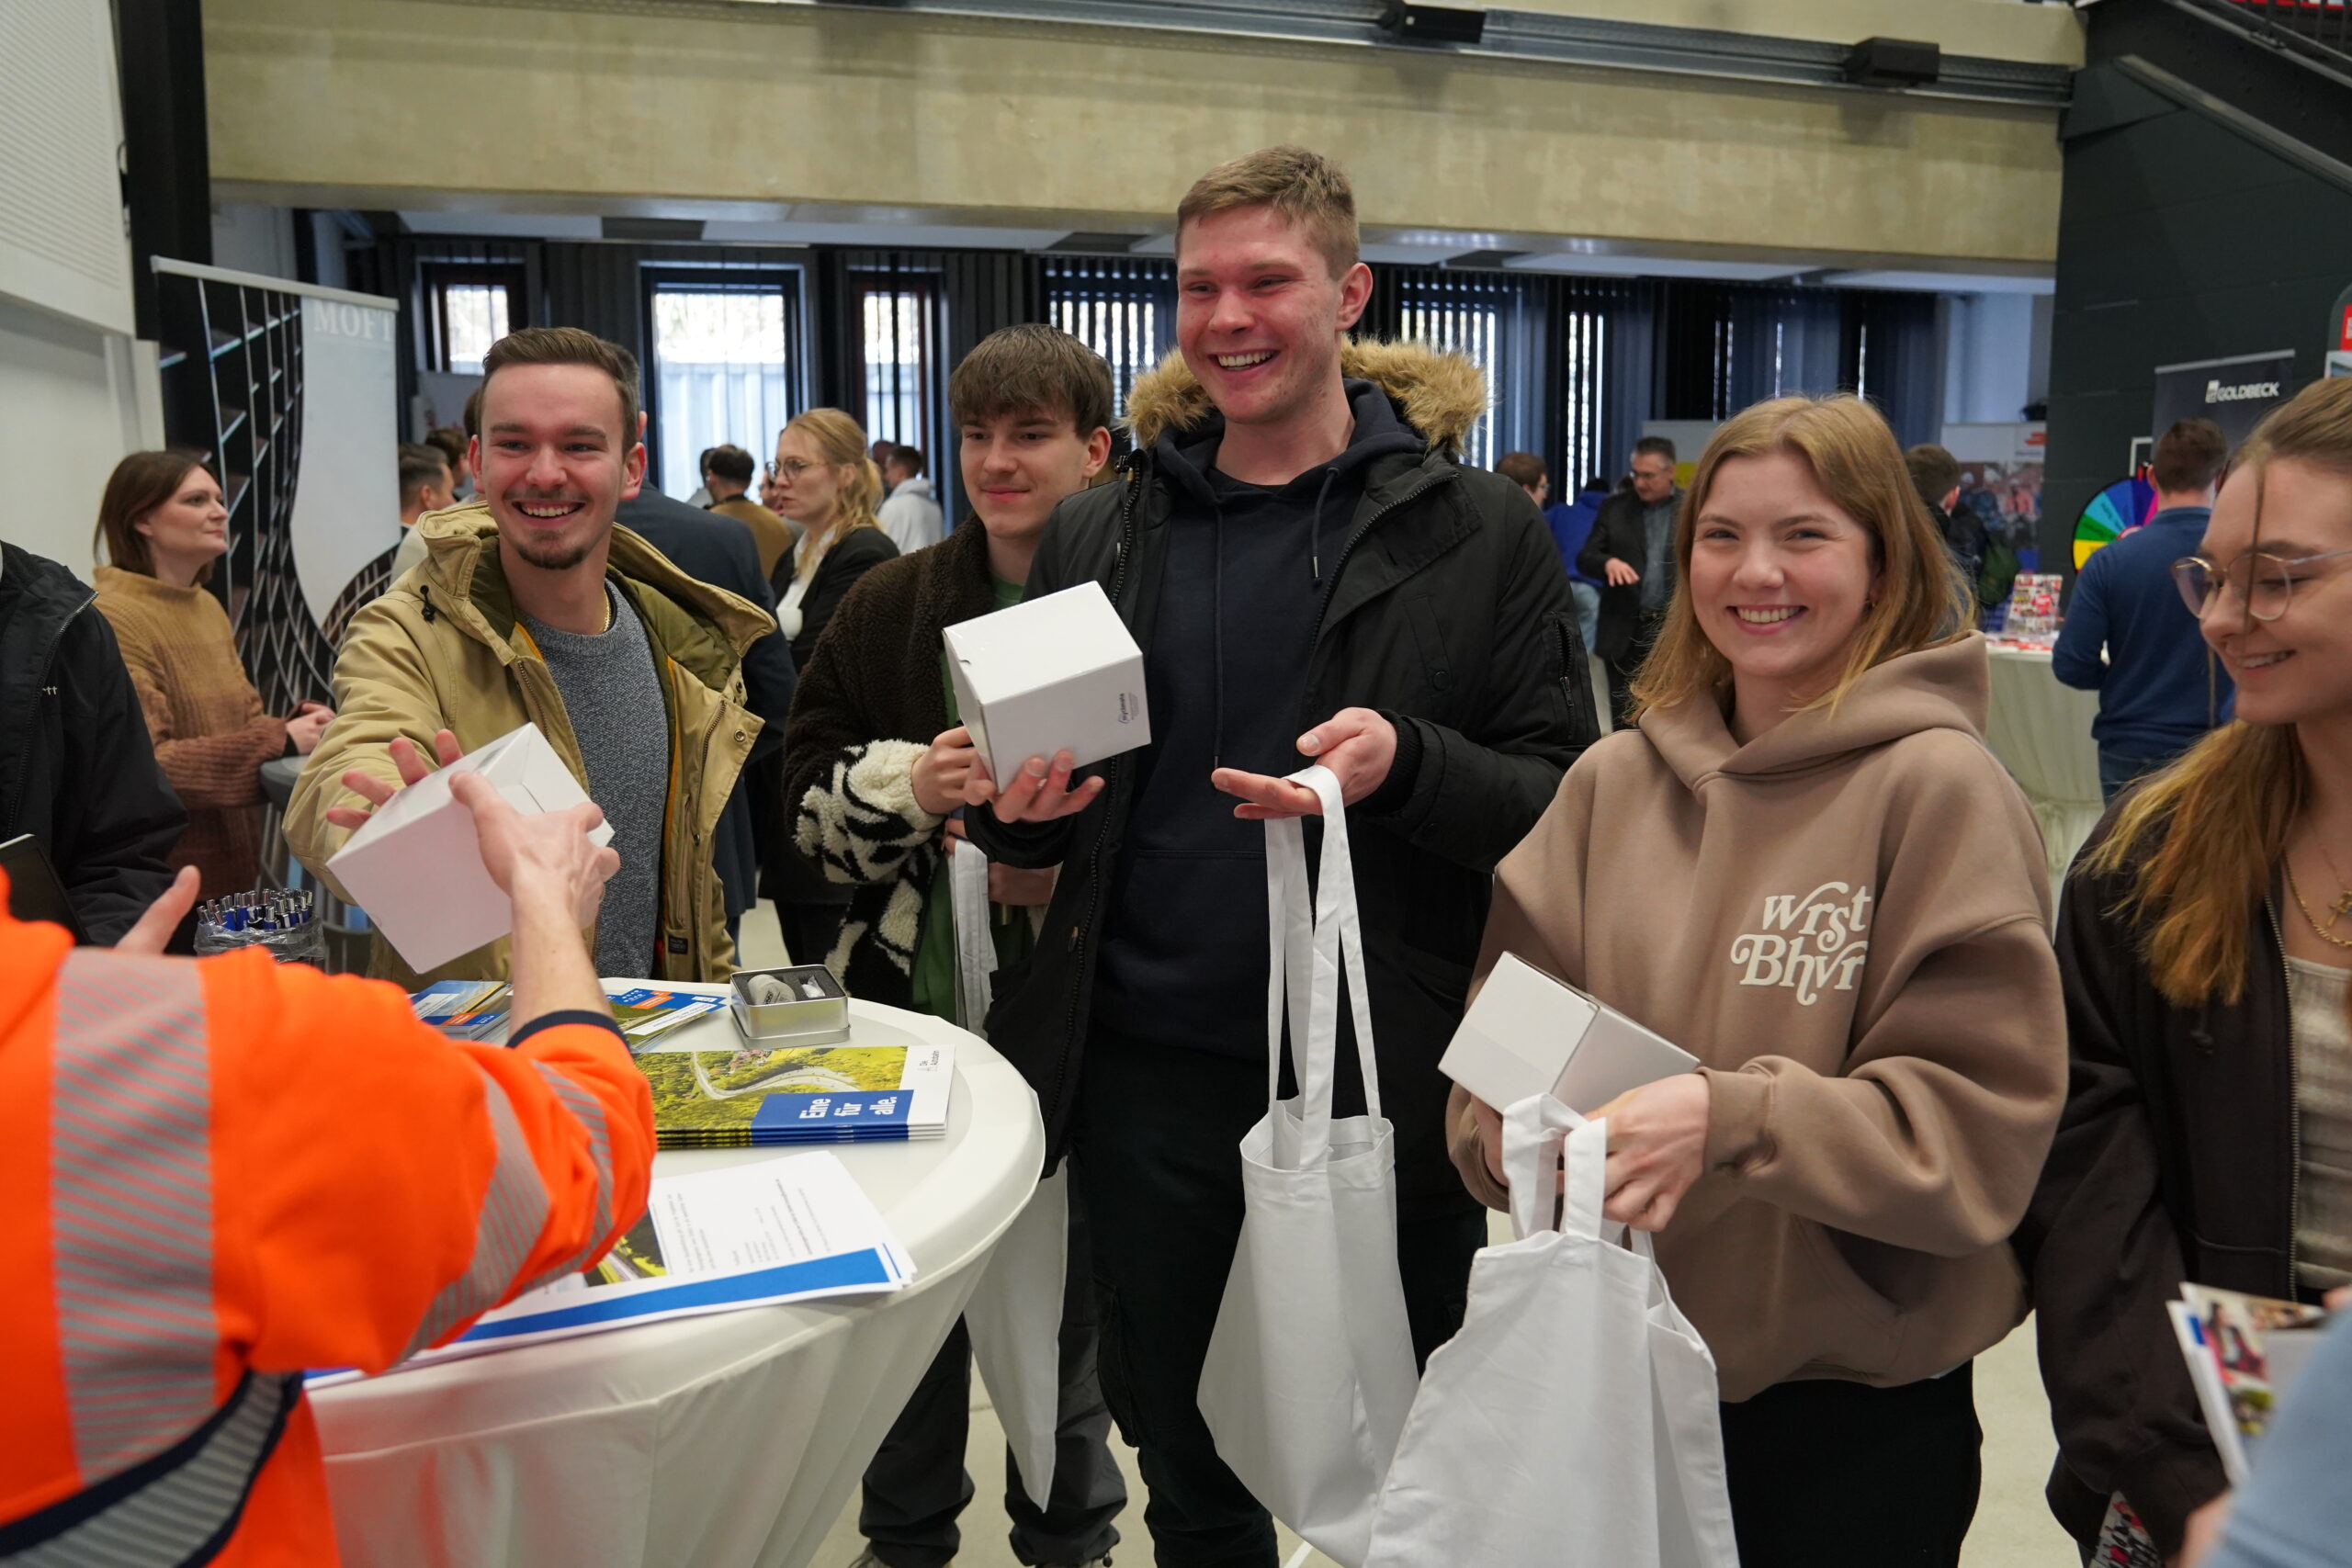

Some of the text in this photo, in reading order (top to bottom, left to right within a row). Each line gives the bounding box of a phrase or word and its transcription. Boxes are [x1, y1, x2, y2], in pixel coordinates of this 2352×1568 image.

[2217, 381, 2280, 401] GOLDBECK
[1762, 881, 1871, 953] Wrst
[1730, 933, 1869, 1006] Bhvr
[798, 1098, 831, 1119] Eine
[834, 1102, 862, 1117] für
[869, 1097, 898, 1115] alle.
